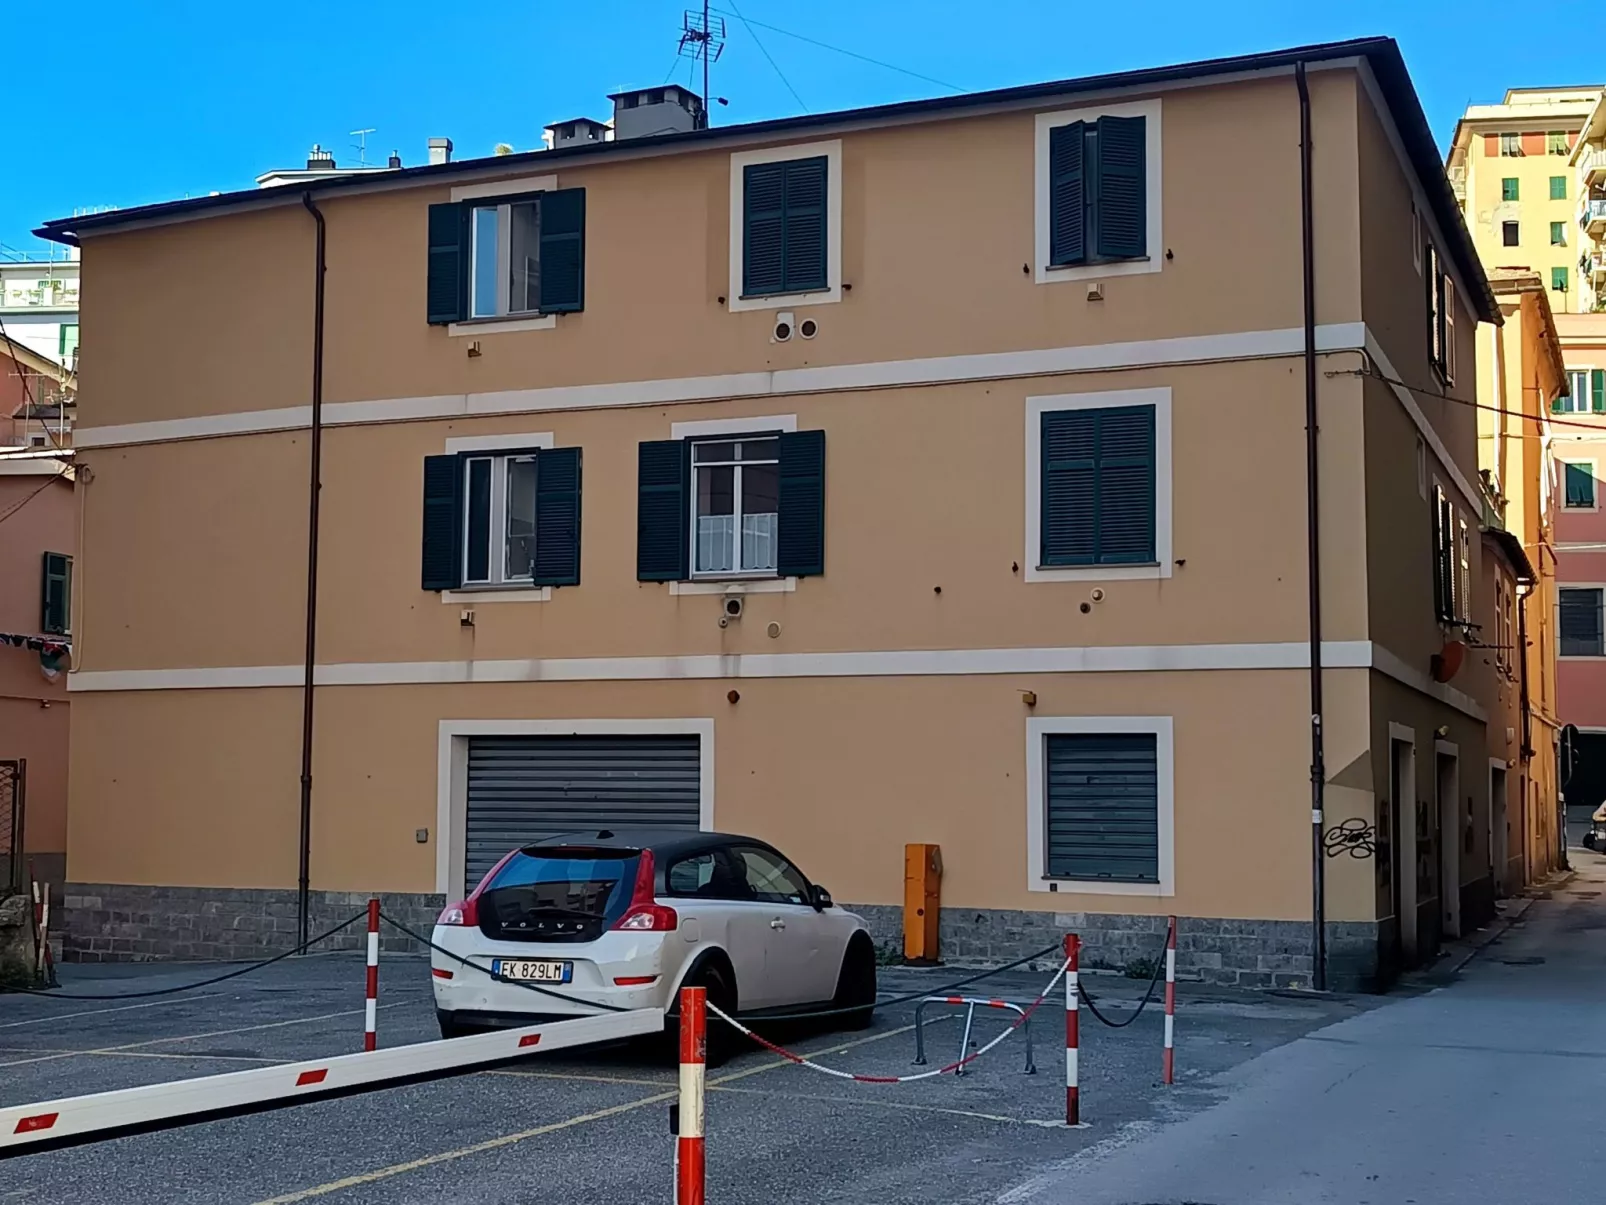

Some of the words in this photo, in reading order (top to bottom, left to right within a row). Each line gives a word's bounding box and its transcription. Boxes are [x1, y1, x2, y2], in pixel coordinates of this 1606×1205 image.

[501, 922, 583, 930] VOLVO
[502, 962, 517, 977] EK
[521, 963, 562, 979] 829LM
